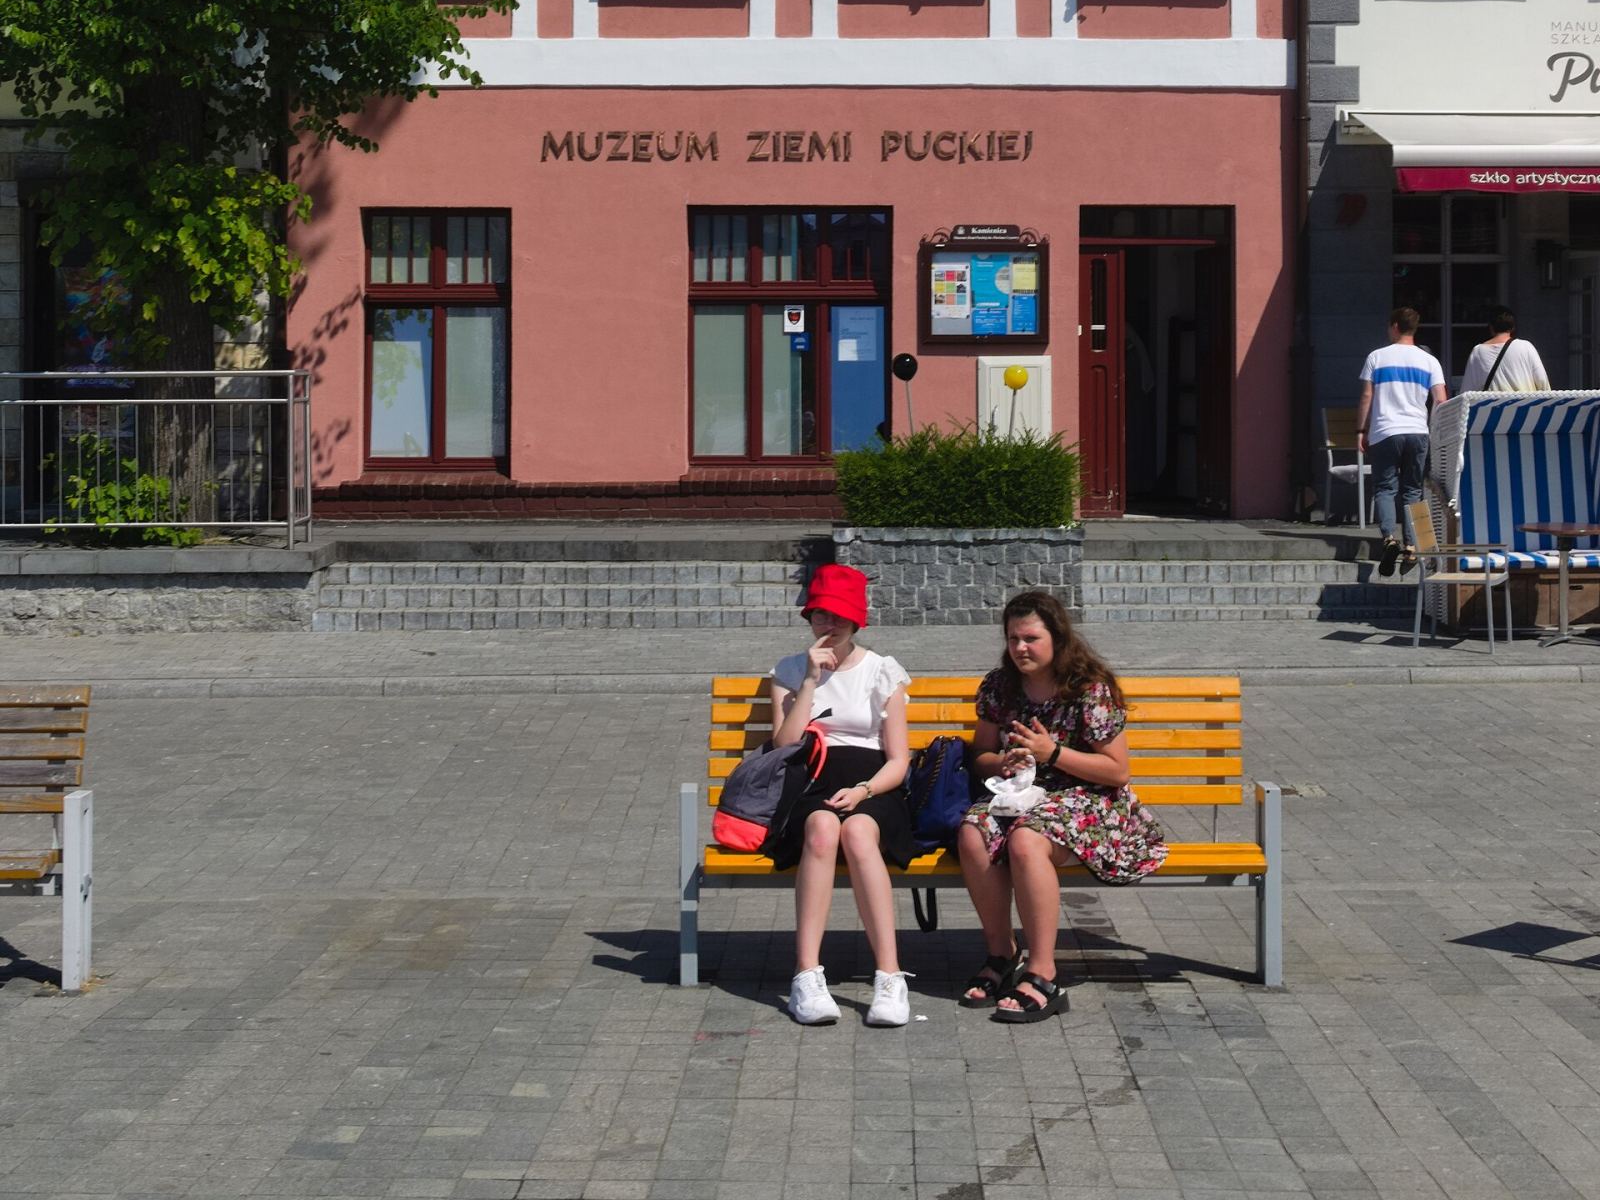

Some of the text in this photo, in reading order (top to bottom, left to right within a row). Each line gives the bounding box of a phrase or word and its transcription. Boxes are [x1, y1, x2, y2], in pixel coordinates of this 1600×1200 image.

[541, 130, 1034, 165] MUZEUM ZIEMI PUCKIEJ
[1470, 170, 1510, 184] szkło
